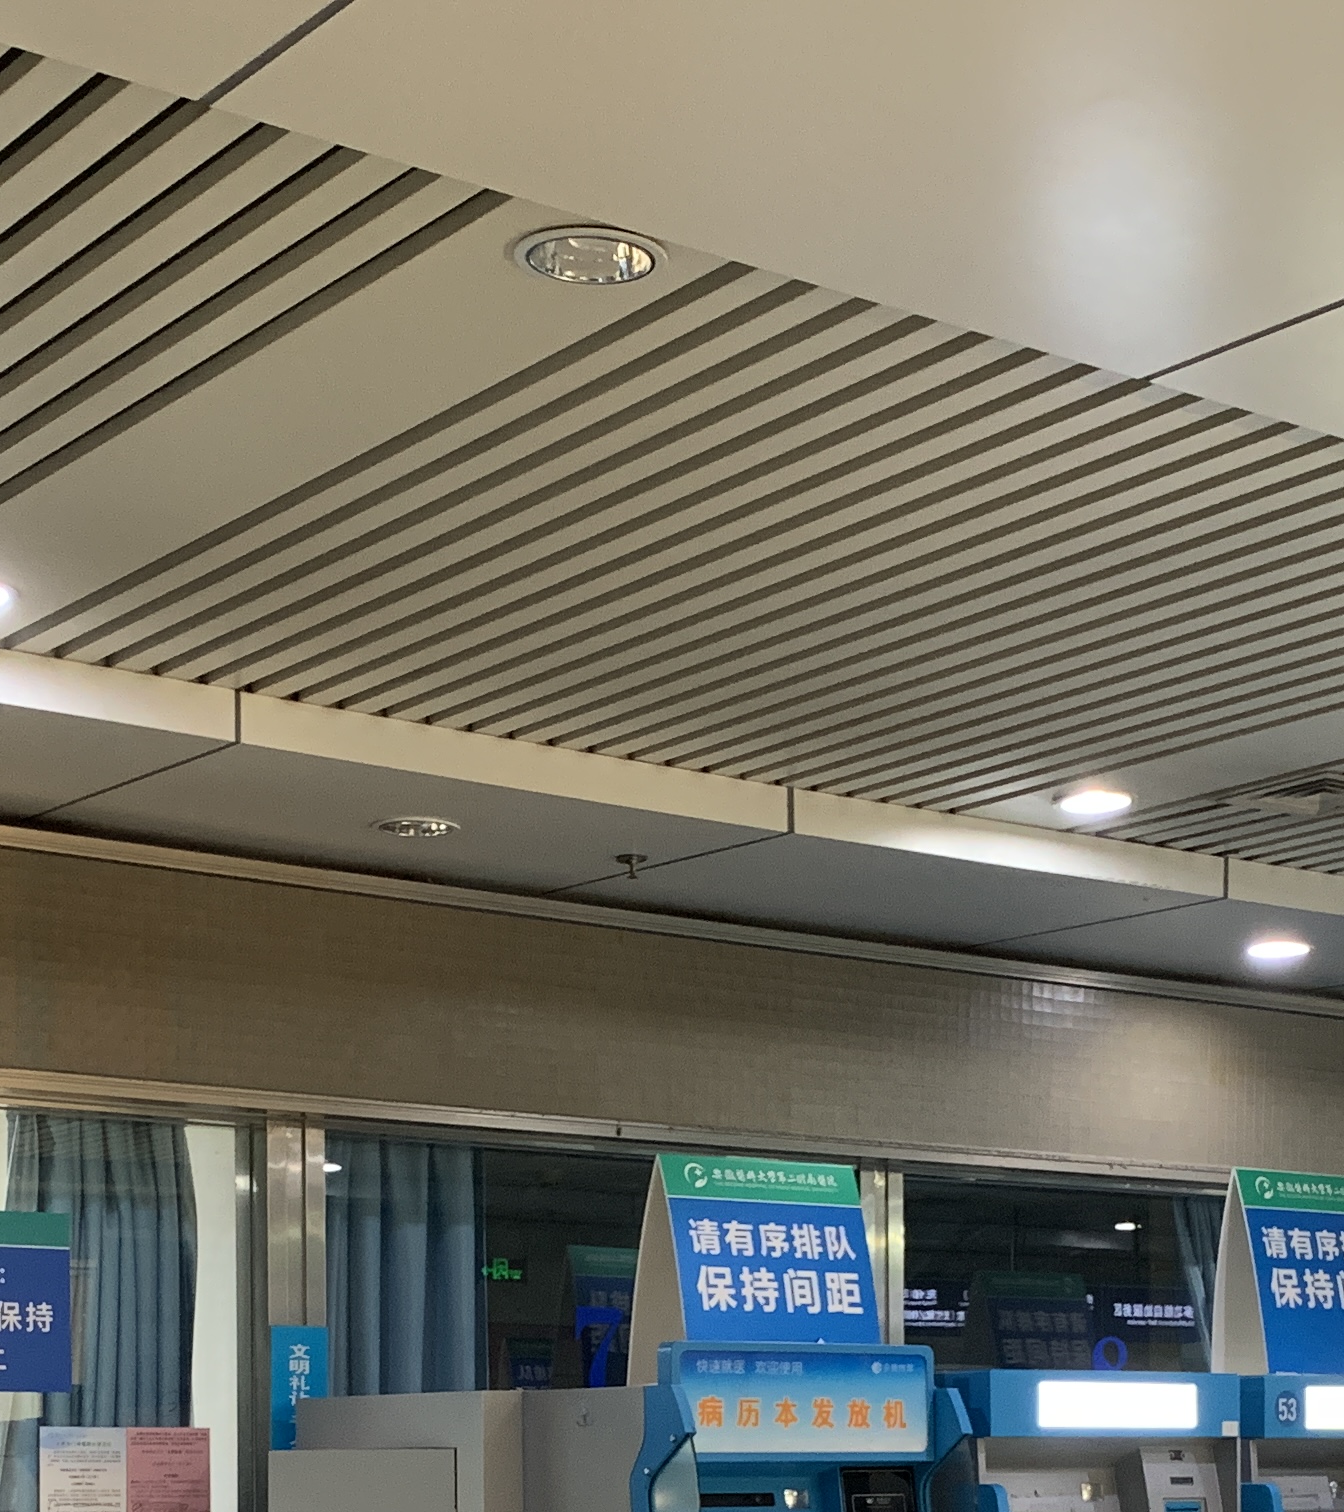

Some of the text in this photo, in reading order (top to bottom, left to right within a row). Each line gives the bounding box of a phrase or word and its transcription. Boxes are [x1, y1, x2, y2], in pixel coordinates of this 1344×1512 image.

[688, 1218, 856, 1261] 请有序排队
[697, 1264, 864, 1315] 保持间距
[697, 1395, 907, 1429] 病历本发放机
[1278, 1397, 1297, 1422] 53
